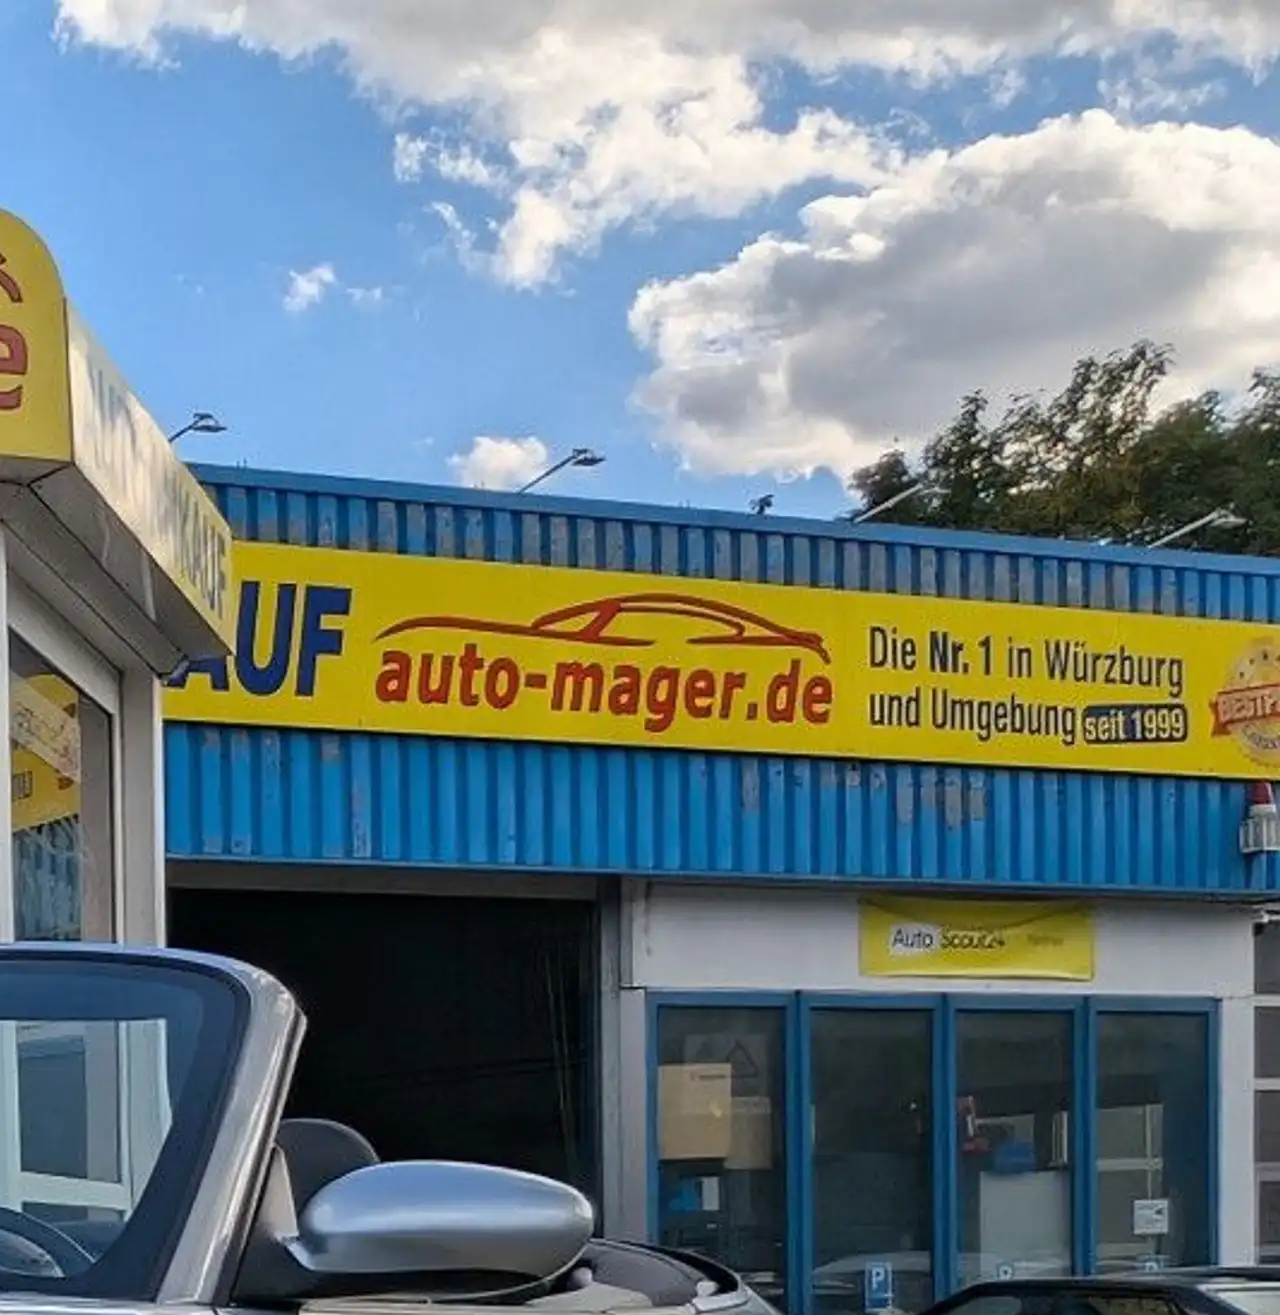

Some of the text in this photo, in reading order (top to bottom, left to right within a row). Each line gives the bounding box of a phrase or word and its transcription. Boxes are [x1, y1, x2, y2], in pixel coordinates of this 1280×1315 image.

[374, 643, 833, 733] auto-mager.de
[869, 626, 1182, 698] Die Nr. 1 in Würzburg
[869, 687, 1184, 746] und Umgebung seit 1999
[892, 928, 934, 948] Auto
